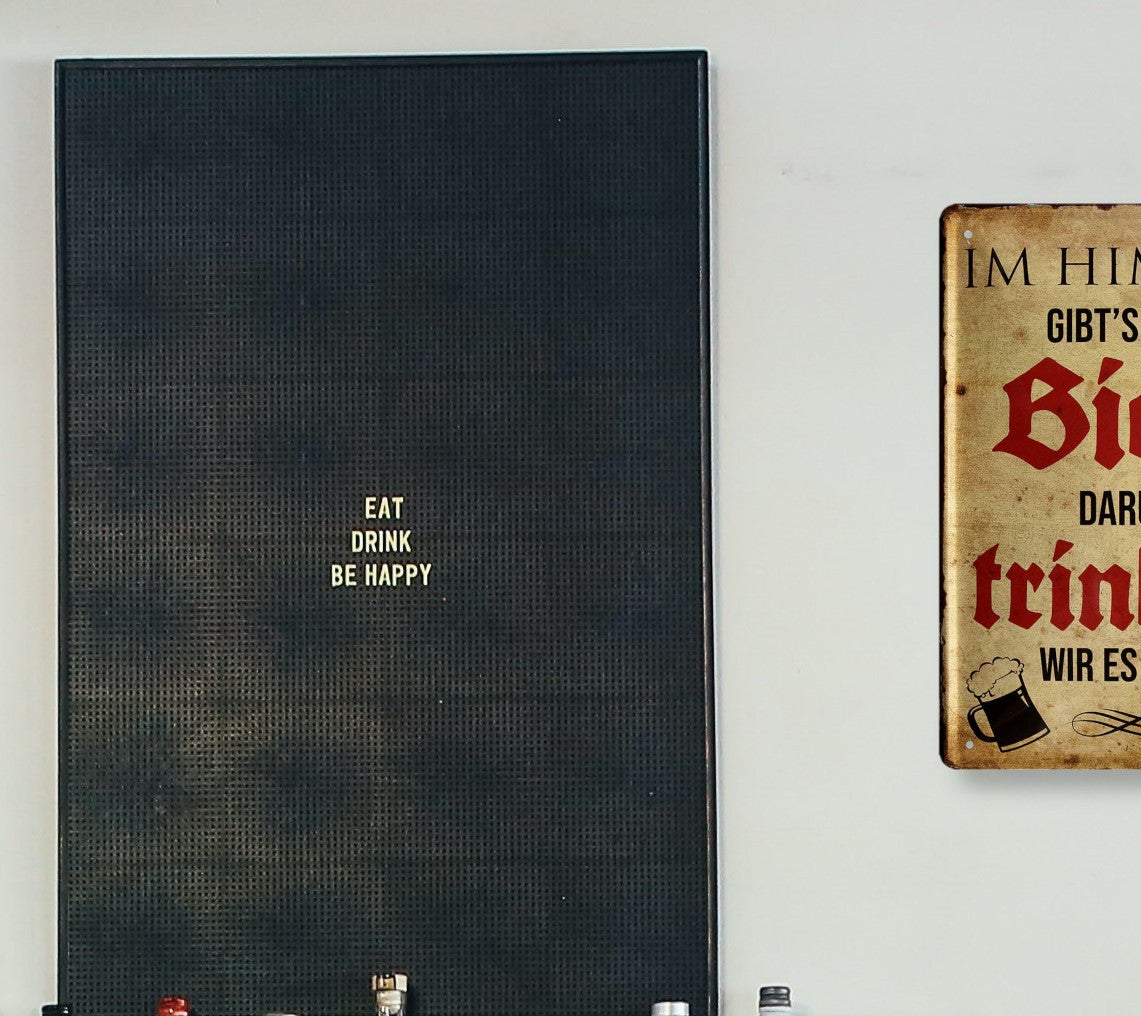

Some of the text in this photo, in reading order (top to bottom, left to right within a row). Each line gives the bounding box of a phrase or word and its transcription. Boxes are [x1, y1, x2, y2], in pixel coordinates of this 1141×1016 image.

[964, 246, 1033, 289] IM
[1046, 307, 1139, 343] GIBT'S
[365, 496, 404, 519] EAT
[351, 529, 412, 553] DRINK
[331, 563, 432, 587] BE HAPPY
[1039, 647, 1094, 682] WIR
[1103, 647, 1138, 682] ES
